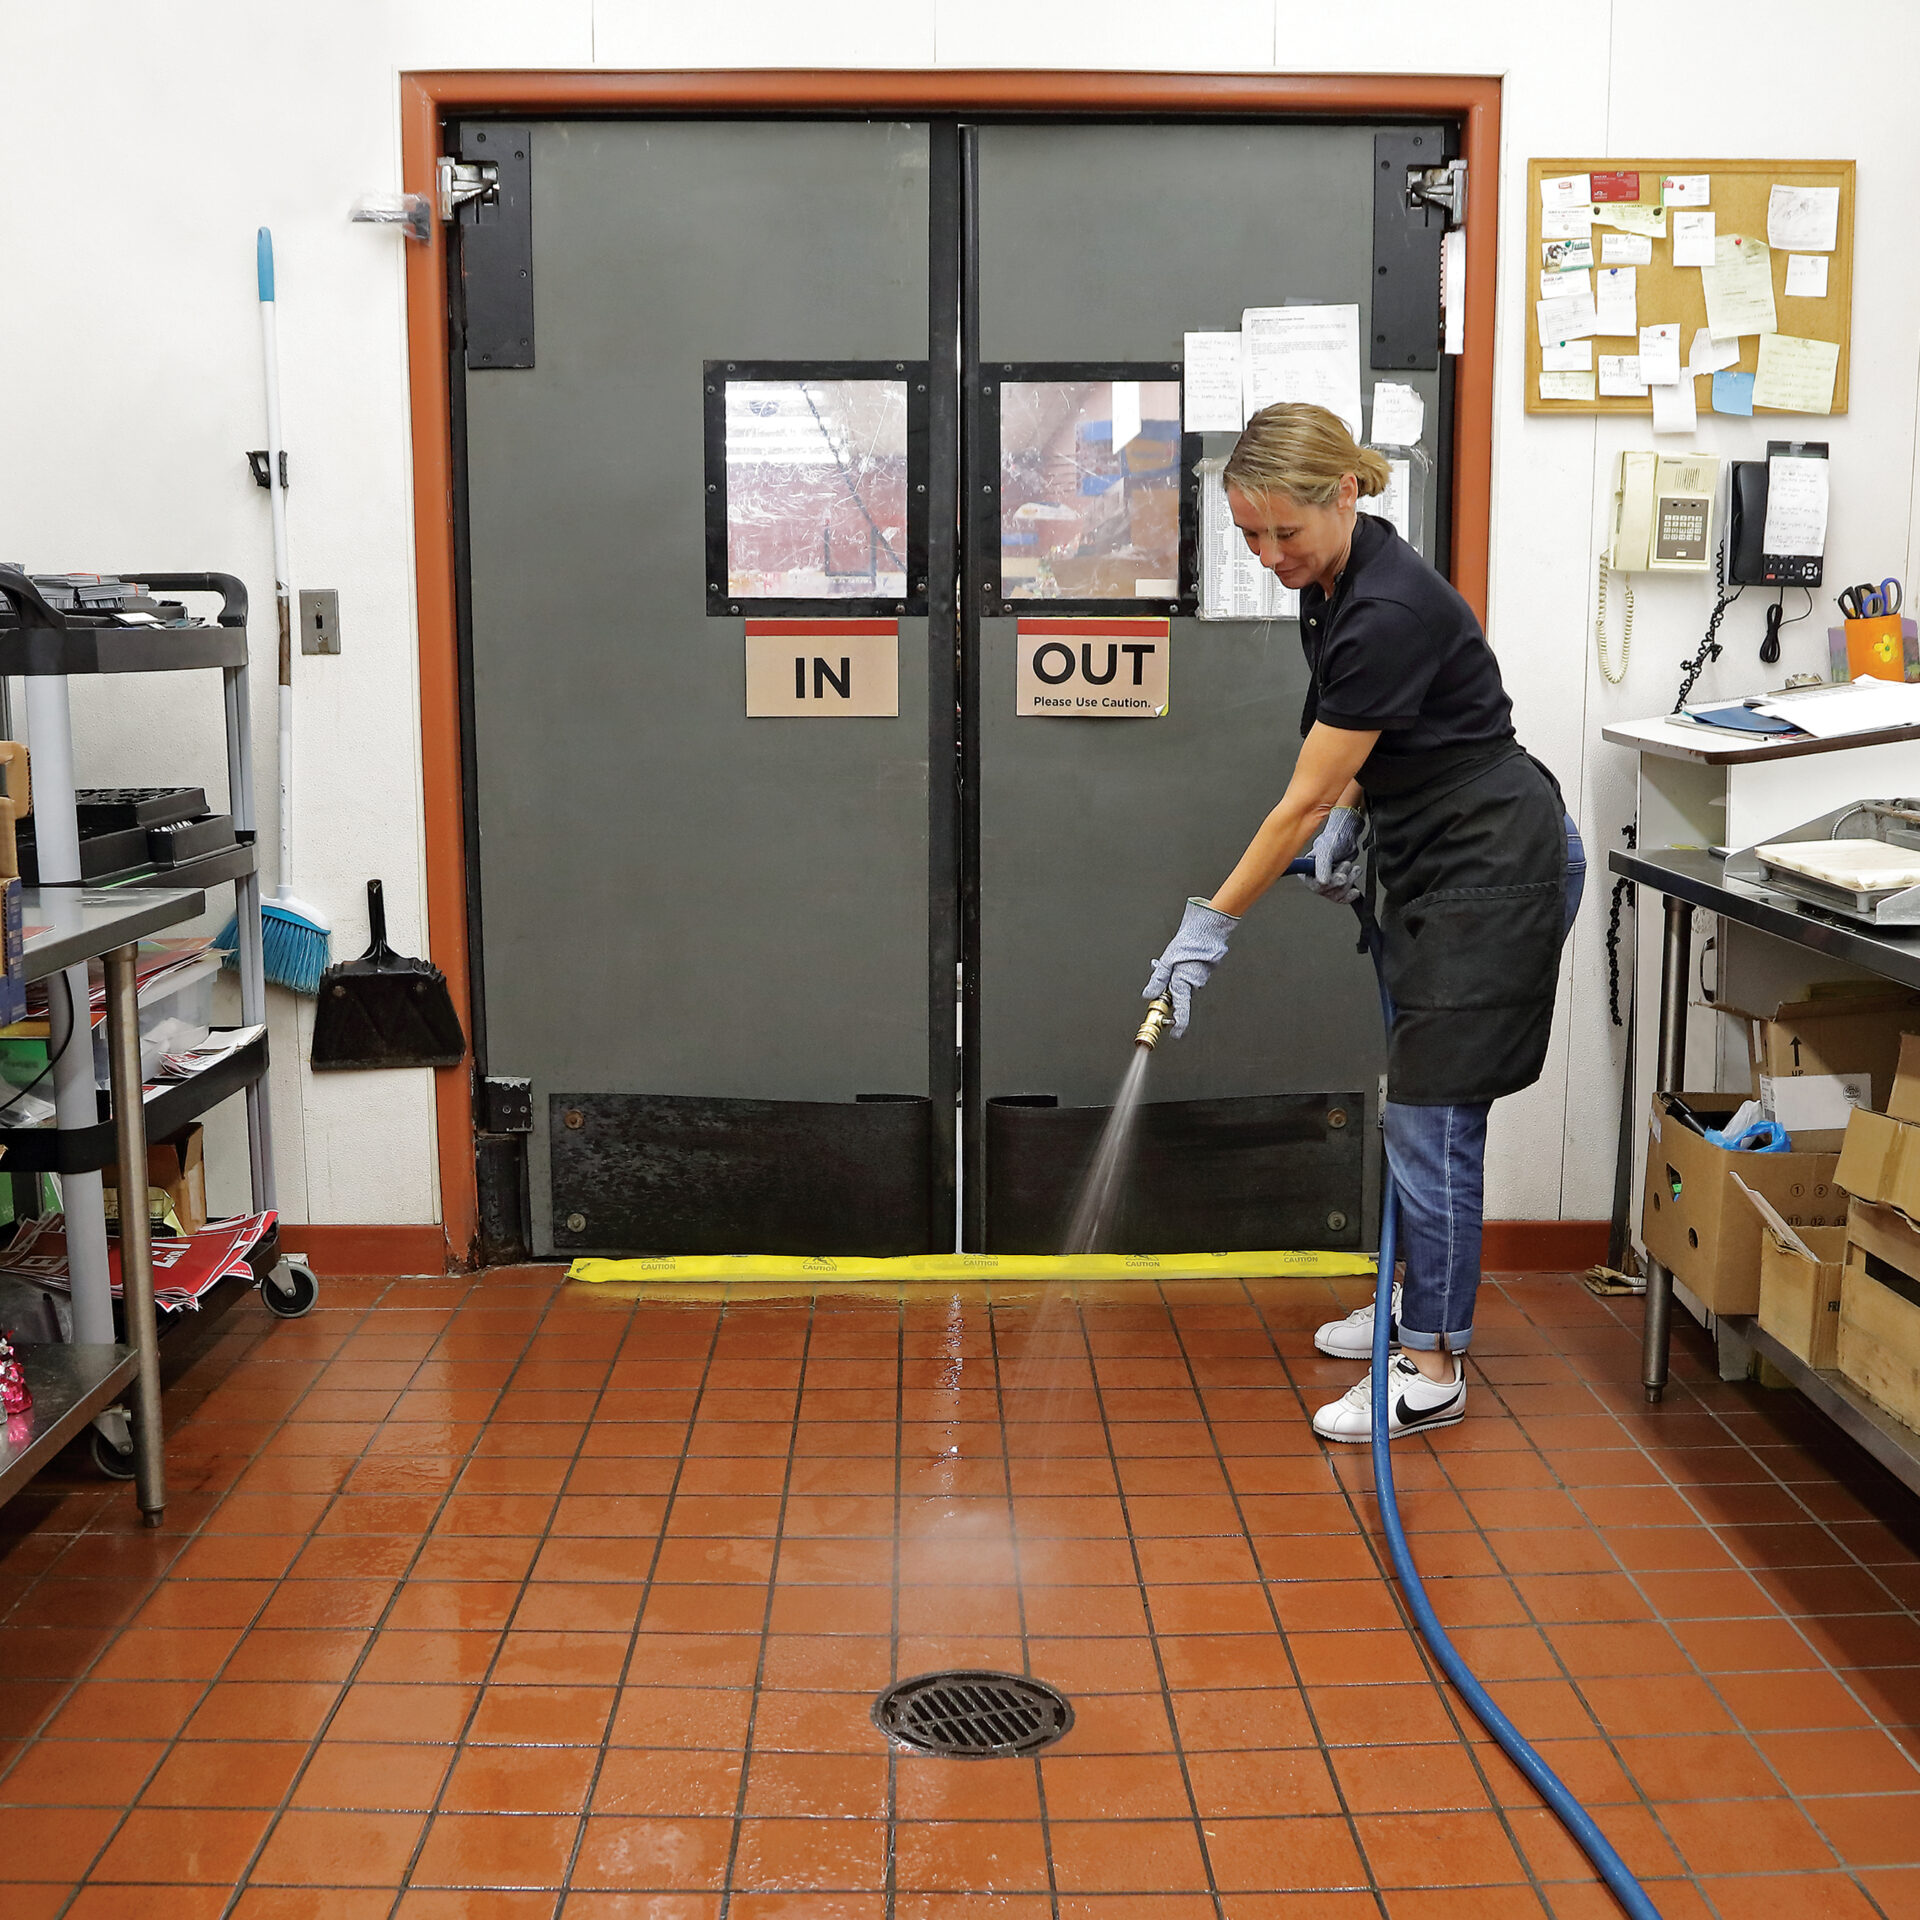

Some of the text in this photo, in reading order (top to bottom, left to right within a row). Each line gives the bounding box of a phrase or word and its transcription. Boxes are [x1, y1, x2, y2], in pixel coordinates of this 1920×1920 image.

[1033, 642, 1155, 685] OUT
[796, 657, 850, 699] IN
[1034, 696, 1151, 708] Please Use Caution.
[641, 1263, 676, 1271] CAUTION
